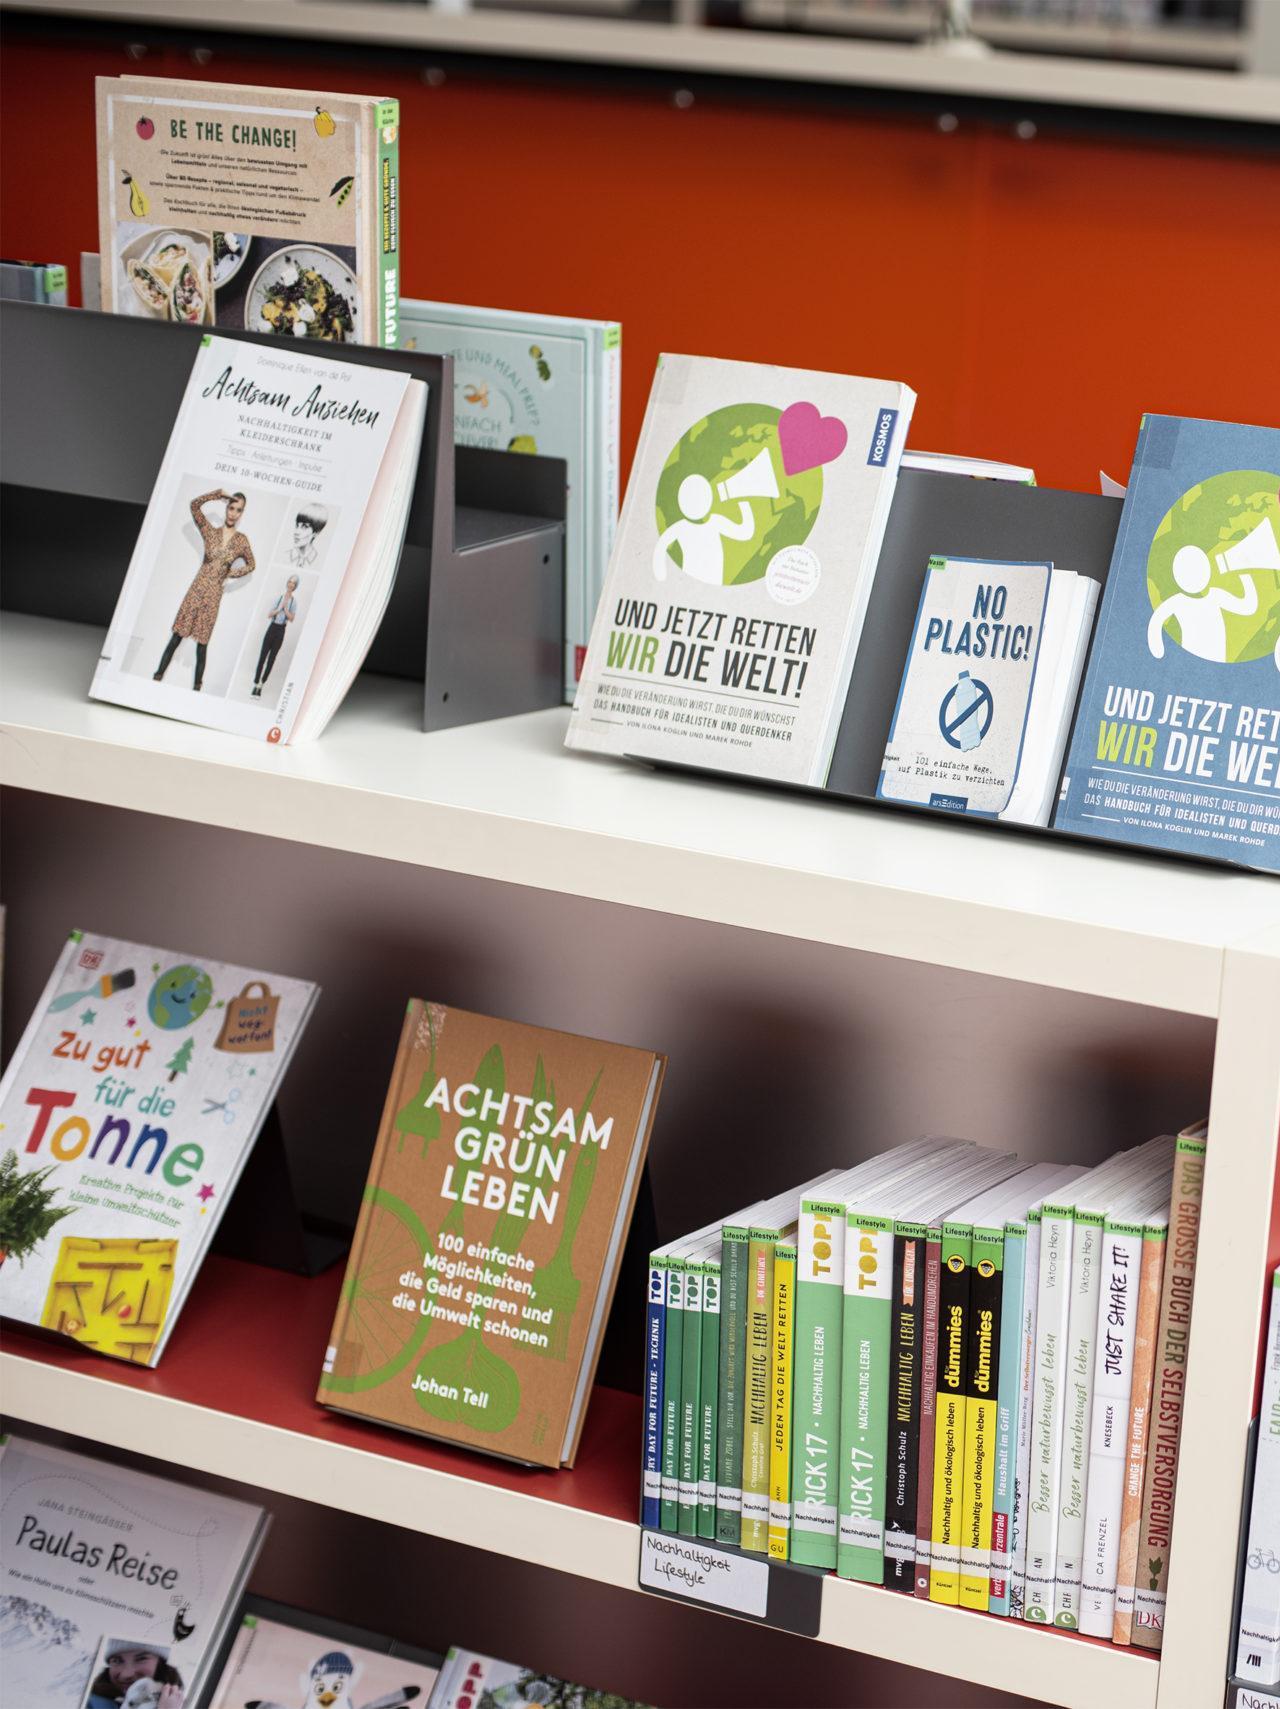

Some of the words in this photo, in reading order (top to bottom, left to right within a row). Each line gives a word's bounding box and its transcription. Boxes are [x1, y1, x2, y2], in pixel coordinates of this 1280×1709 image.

[170, 119, 187, 138] BE
[196, 122, 223, 142] THE
[232, 125, 296, 152] CHANGE!
[385, 268, 396, 345] FUTURE
[202, 366, 290, 412] Achtsam
[292, 384, 379, 429] Anziehen
[238, 415, 319, 438] NACHHALTIGKEIT
[321, 432, 332, 440] IM
[240, 429, 322, 452] KLEIDERSCHRANK
[872, 414, 892, 462] KOSMOS
[215, 463, 237, 474] DEIN
[972, 584, 1008, 621] NO
[615, 599, 658, 630] UND
[661, 606, 727, 641] JETZT
[730, 617, 817, 656] RETTEN
[924, 618, 1033, 661] PLASTIC!
[606, 631, 659, 673] WIR
[664, 641, 714, 682] DIE
[721, 649, 809, 698] WELT!
[1104, 686, 1154, 721] UND
[1158, 694, 1232, 733] JETZT
[916, 756, 929, 764] 101
[934, 761, 969, 771] einfache
[1096, 720, 1157, 768] WIR
[1164, 731, 1219, 778] DIE
[915, 768, 947, 779] Plastik
[966, 776, 1004, 786] verzichten
[1088, 778, 1103, 789] WIE
[1104, 780, 1116, 791] DU
[1116, 782, 1130, 794] DIE
[1131, 784, 1191, 804] VERÄNDERUNG
[1193, 795, 1220, 810] WIRST,
[1222, 800, 1236, 811] DIE
[1237, 802, 1249, 813] DU
[1249, 804, 1263, 816] DIR
[1084, 794, 1101, 805] DAS
[1104, 797, 1151, 813] HANDBUCH
[1154, 805, 1171, 817] FÜR
[1175, 808, 1226, 826] IDEALISTEN
[1229, 817, 1247, 829] UND
[52, 1031, 88, 1061] Zu
[92, 1040, 151, 1073] gut
[95, 1076, 135, 1108] für
[138, 1086, 176, 1117] die
[424, 1077, 614, 1150] ACHTSAM
[25, 1087, 204, 1186] Tonne
[454, 1127, 566, 1182] GRÜN
[440, 1166, 559, 1224] LEBEN
[1181, 1161, 1203, 1197] DAS
[810, 1204, 840, 1214] Lifestyle
[438, 1232, 464, 1253] 100
[467, 1242, 535, 1272] einfache
[1118, 1246, 1129, 1268] IT!
[1173, 1202, 1199, 1272] GROSSE
[423, 1252, 536, 1299] Möglichkeiten,
[400, 1271, 423, 1290] die
[427, 1278, 463, 1300] Geld
[465, 1291, 518, 1315] sparen
[522, 1306, 553, 1324] und
[779, 1284, 787, 1326] RETTEN
[1108, 1273, 1127, 1328] SHARE
[1168, 1275, 1192, 1324] BUCH
[392, 1293, 416, 1311] die
[420, 1299, 480, 1329] Umwelt
[484, 1320, 548, 1347] schonen
[814, 1326, 825, 1356] LEBEN
[948, 1306, 962, 1388] dummies
[1105, 1335, 1123, 1374] JUST
[1165, 1329, 1187, 1364] DER
[412, 1374, 458, 1400] Johan
[463, 1387, 489, 1408] Tell
[777, 1365, 785, 1385] DIE
[813, 1358, 824, 1415] NACHHALTIG
[805, 1433, 828, 1454] 17
[1104, 1406, 1114, 1447] KNESEBECK
[945, 1428, 955, 1476] ökologisch
[1147, 1368, 1184, 1548] SELBSTVERSORGUNG
[805, 1456, 828, 1511] RICK
[944, 1478, 952, 1495] und
[795, 1514, 835, 1525] Nachhaltigkeit
[943, 1496, 953, 1544] Nachhaltig
[15, 1515, 103, 1569] Paulas
[106, 1543, 178, 1590] Reise
[647, 1537, 731, 1572] Nachhaltigkeit
[654, 1559, 705, 1586] Lifestyle
